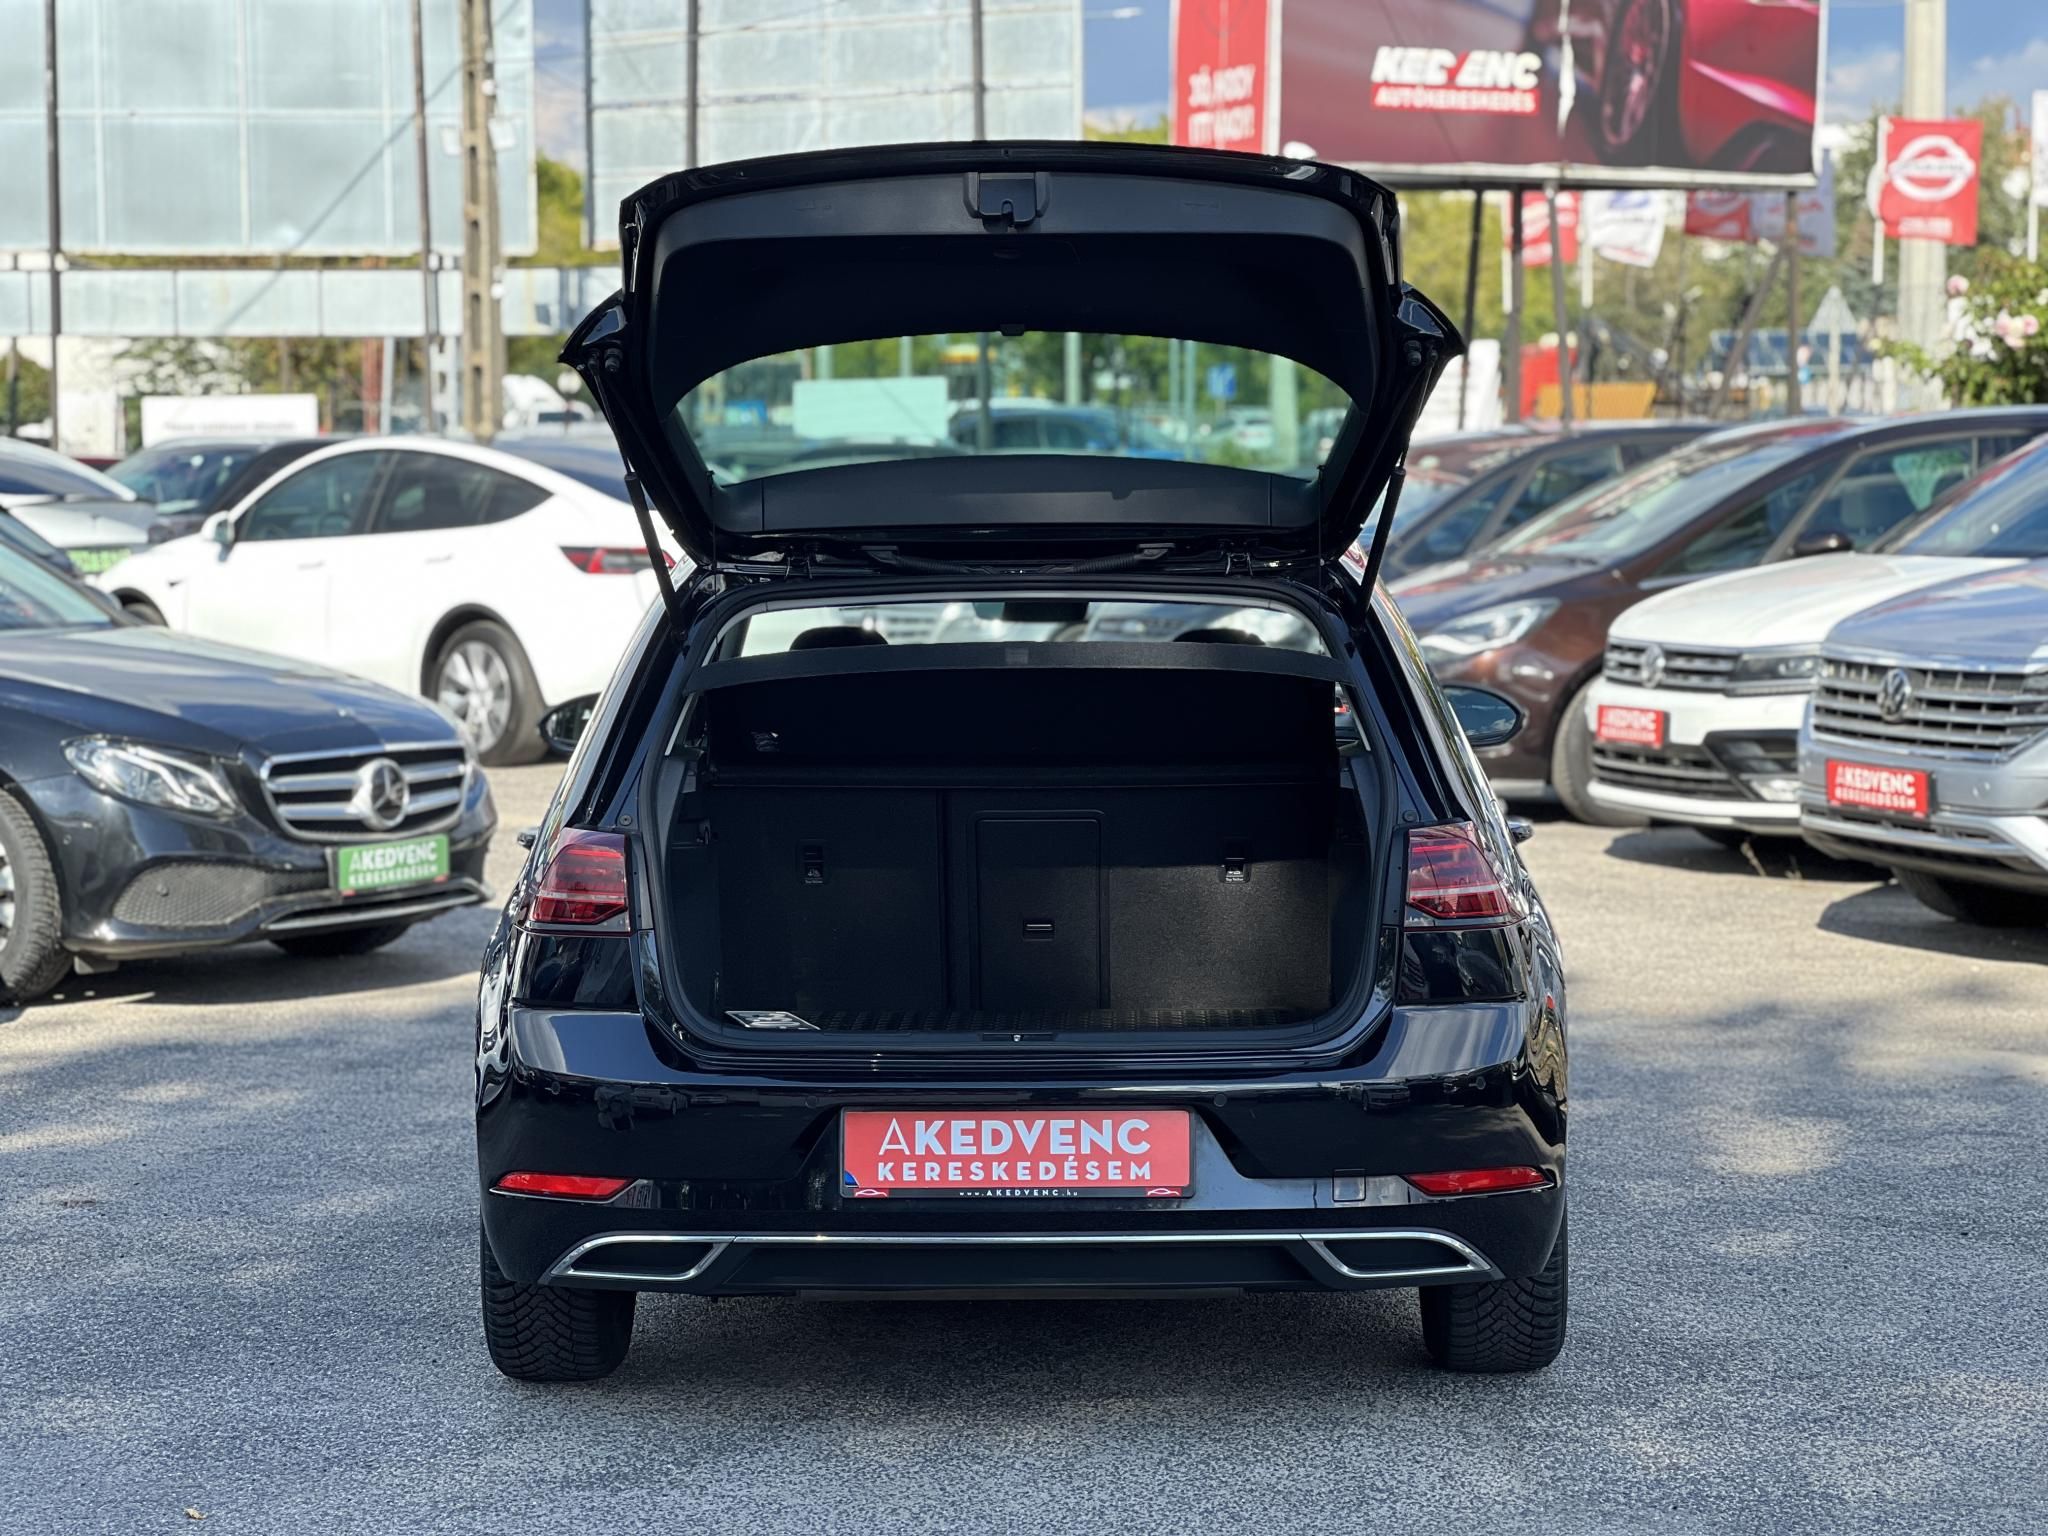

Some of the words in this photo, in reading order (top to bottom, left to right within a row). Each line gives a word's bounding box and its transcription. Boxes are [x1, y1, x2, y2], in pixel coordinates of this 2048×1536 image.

[1834, 765, 1916, 796] AKEDVENC
[349, 841, 438, 872] AKEDVENC
[878, 1117, 1151, 1156] AKEDVENC
[877, 1156, 1151, 1183] KERESKEDÉSEM
[959, 1188, 1079, 1197] www.AKEDVENC.hu
